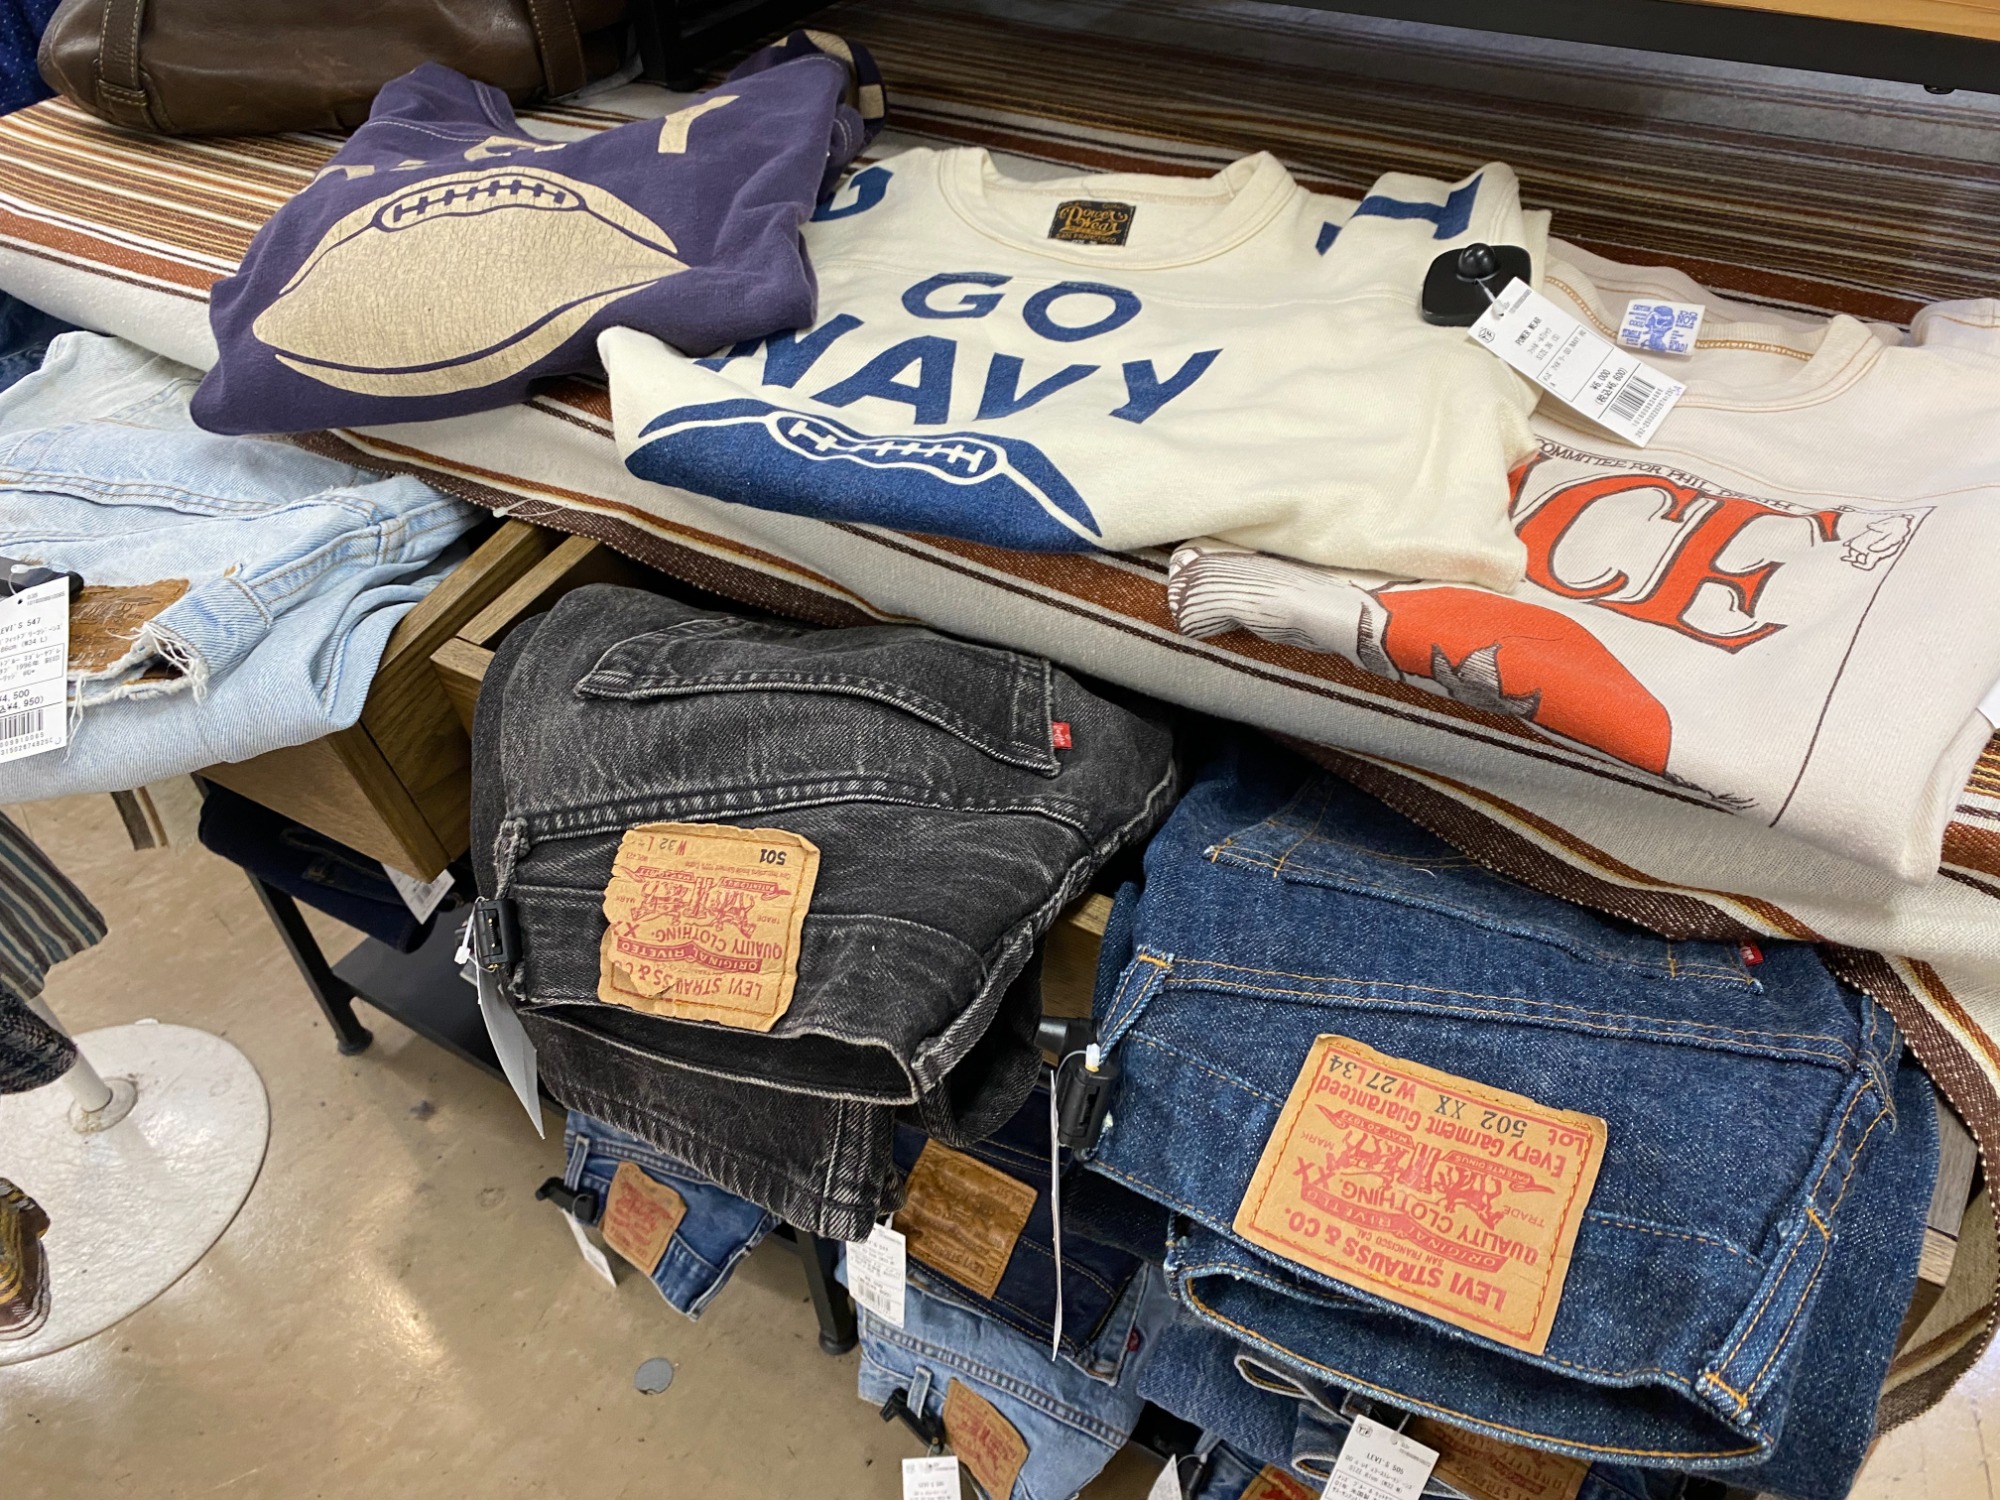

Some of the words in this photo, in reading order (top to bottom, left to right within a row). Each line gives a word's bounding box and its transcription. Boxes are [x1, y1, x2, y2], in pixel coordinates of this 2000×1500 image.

[1059, 205, 1128, 228] Power
[1080, 218, 1121, 233] Wear
[1056, 232, 1073, 240] SAN
[1073, 233, 1117, 244] FRANCISCO
[902, 271, 1141, 342] GO
[1514, 328, 1531, 346] POWER
[1526, 315, 1541, 330] WEAR
[693, 313, 1223, 425] NAVY
[1629, 462, 1662, 475] FOR
[1668, 469, 1712, 493] PHIL
[0, 622, 23, 635] EVI'S
[27, 617, 41, 628] 547
[759, 848, 787, 865] 501
[615, 895, 635, 903] MARK
[756, 914, 780, 923] TRADE
[621, 942, 683, 957] RIVETED
[692, 946, 757, 970] ORIGINAL
[732, 939, 781, 959] QUALITY
[637, 964, 650, 980] &
[652, 968, 720, 995] STRAUSS
[728, 977, 762, 1000] LEVI
[1314, 1074, 1422, 1133] Guaranteed
[1433, 1093, 1467, 1120] XX
[1366, 1122, 1381, 1132] 20
[1383, 1128, 1408, 1142] MAY
[1418, 1113, 1506, 1158] Garment
[1478, 1107, 1527, 1140] 502
[1299, 1130, 1335, 1150] MARK
[1544, 1128, 1586, 1155] Lot
[1506, 1140, 1567, 1179] Every
[1292, 1156, 1335, 1189] XX
[1338, 1178, 1453, 1235] CLOTHING.
[1501, 1204, 1547, 1227] TRADE
[1283, 1207, 1321, 1239] CO.
[1321, 1223, 1343, 1246] &
[1375, 1235, 1422, 1260] FRANCISCO
[1407, 1225, 1495, 1266] ORIGINAL
[1455, 1228, 1537, 1264] QUALITY
[1341, 1235, 1443, 1287] STRAUSS
[1424, 1253, 1444, 1267] SAN
[1448, 1271, 1507, 1312] LEVI
[1366, 1452, 1390, 1467] LEVI'S
[1391, 1464, 1404, 1474] 505
